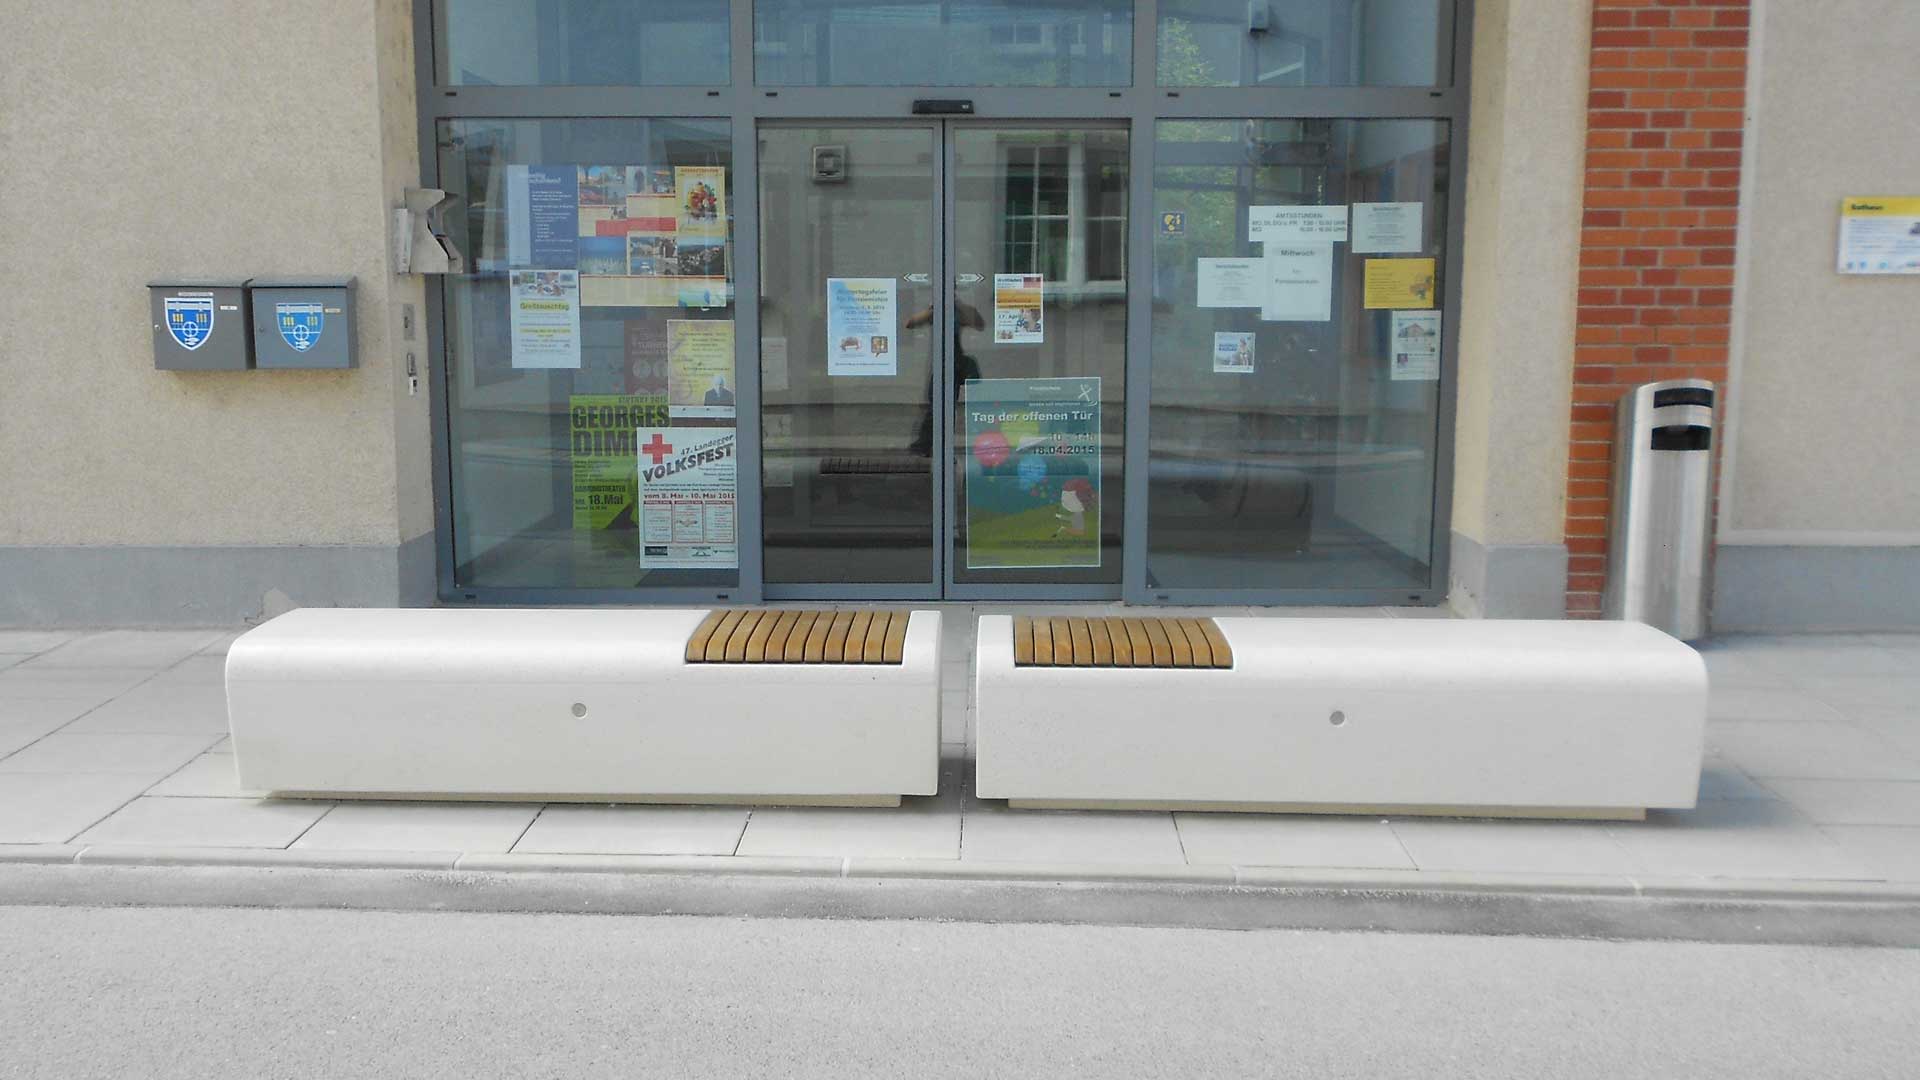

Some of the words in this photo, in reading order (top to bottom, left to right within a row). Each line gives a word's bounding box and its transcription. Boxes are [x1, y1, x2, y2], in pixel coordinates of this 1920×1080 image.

[1280, 248, 1316, 256] Mittwoch
[573, 404, 670, 429] GEORGES
[971, 411, 995, 424] Tag
[998, 411, 1019, 421] der
[1022, 411, 1068, 421] offenen
[1071, 410, 1094, 420] Tür
[573, 430, 638, 457] DIM
[1032, 445, 1096, 455] 18.04.2015
[642, 442, 735, 483] VOLKSFEST
